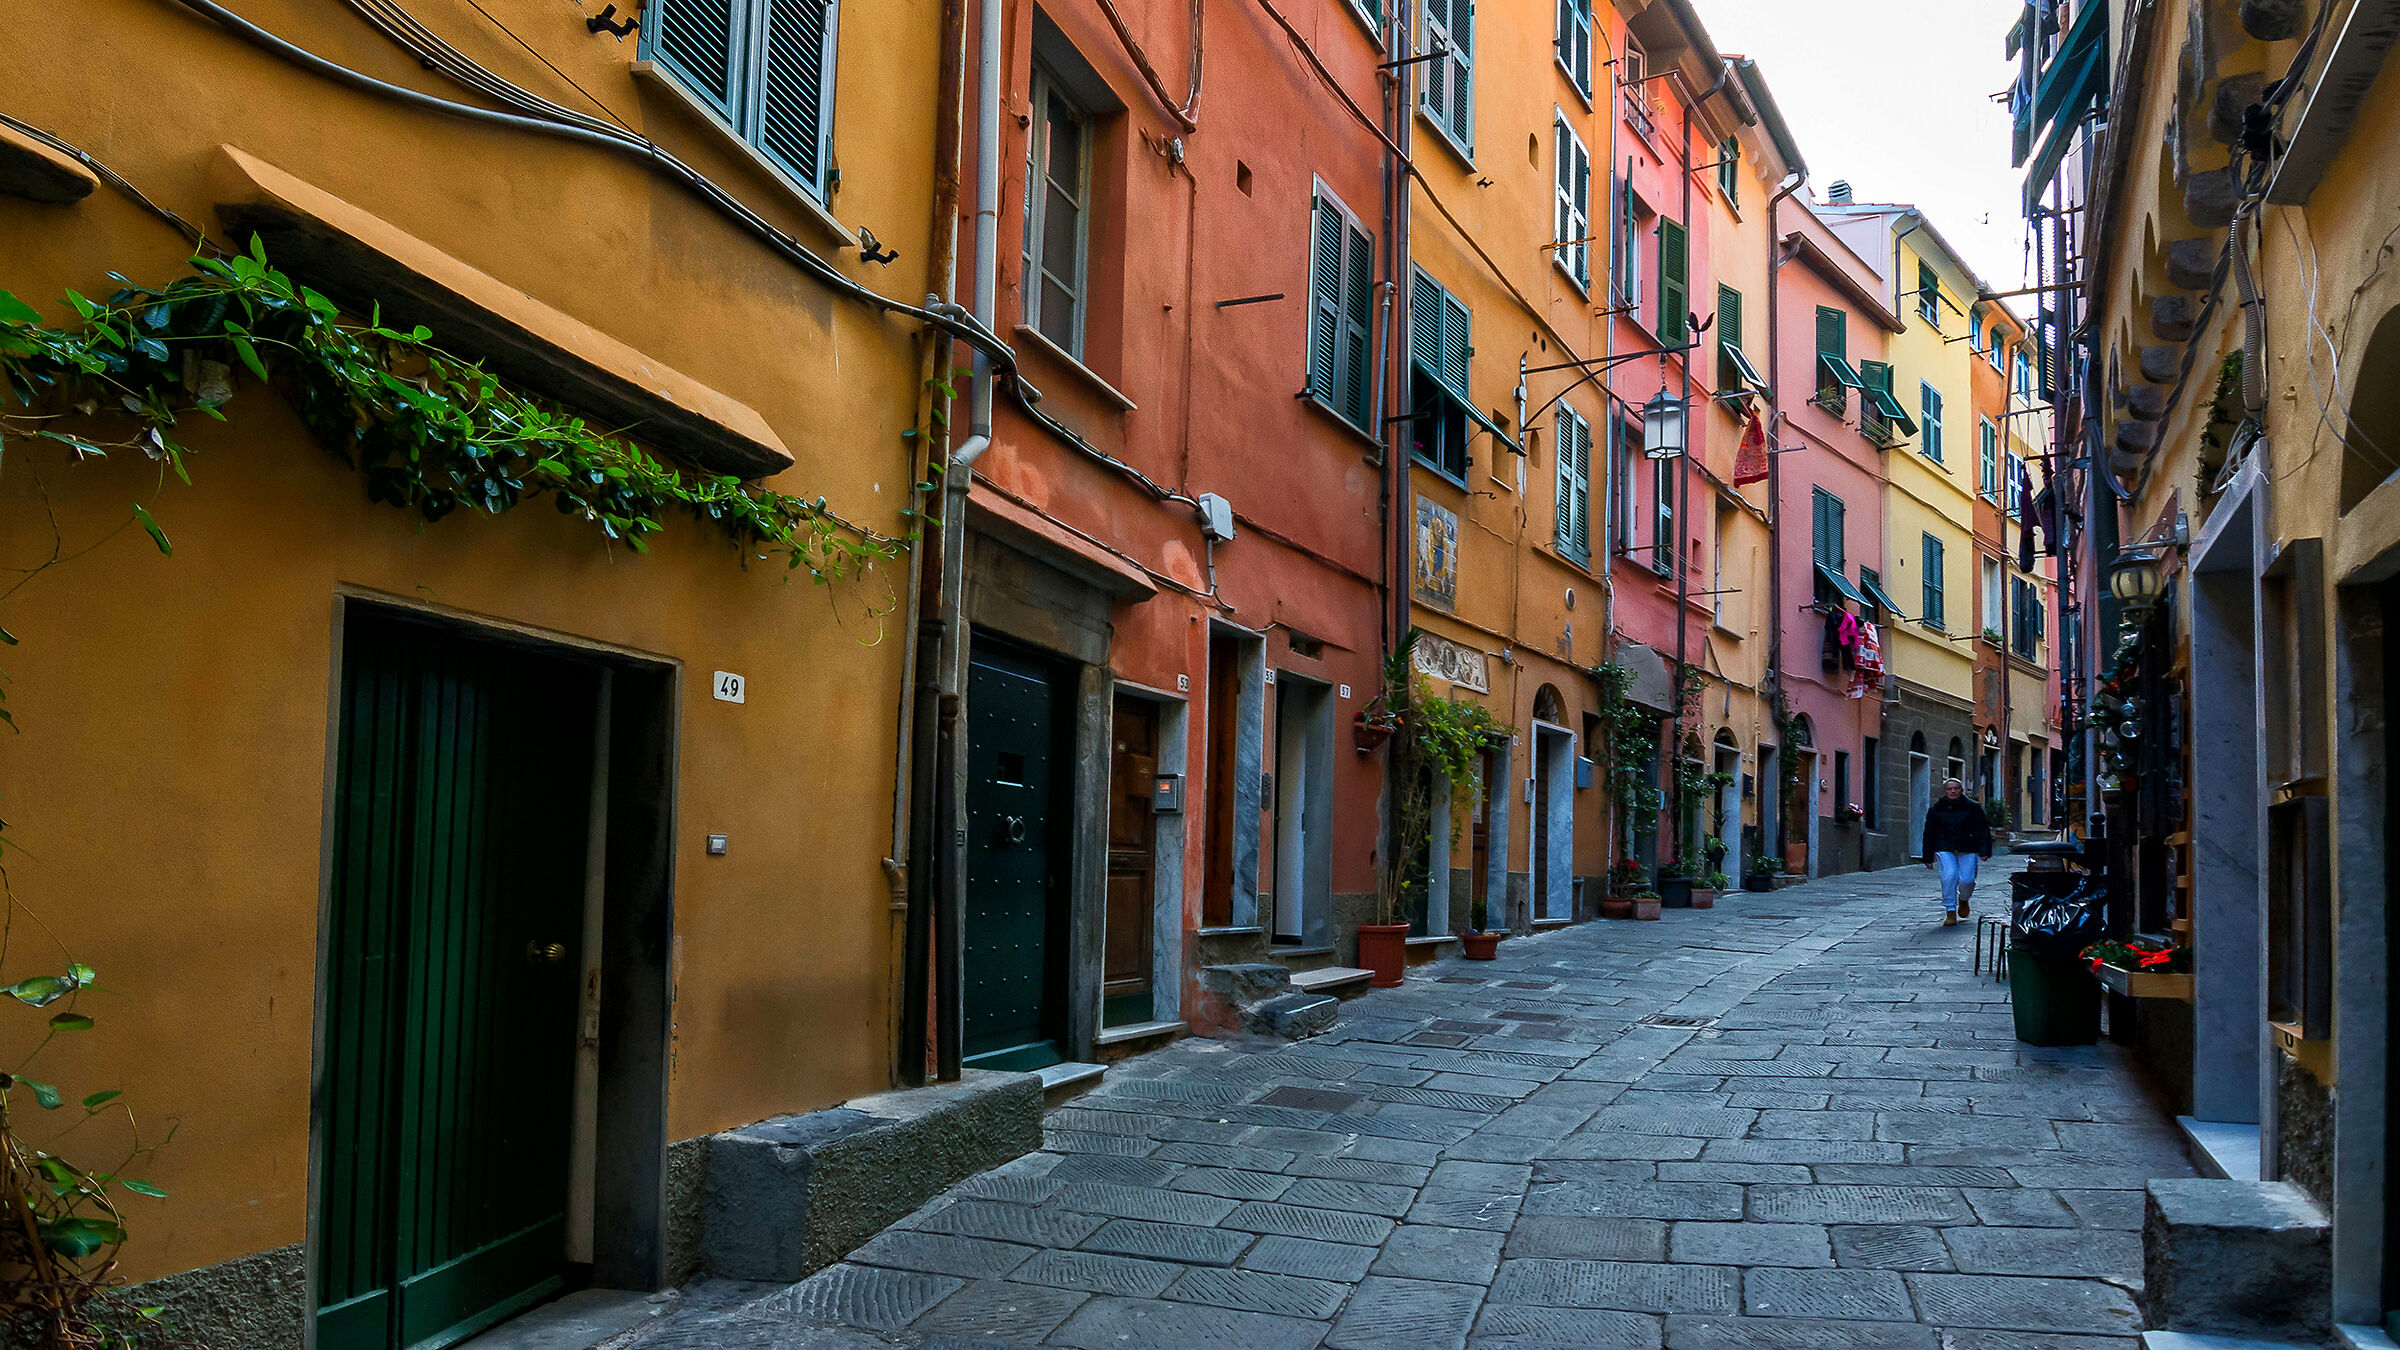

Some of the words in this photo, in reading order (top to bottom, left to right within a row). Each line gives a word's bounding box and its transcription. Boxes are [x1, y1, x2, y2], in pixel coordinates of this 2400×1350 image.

[1265, 670, 1274, 682] 55
[720, 676, 739, 697] 49
[1180, 677, 1189, 690] 53
[1341, 686, 1350, 696] 57
